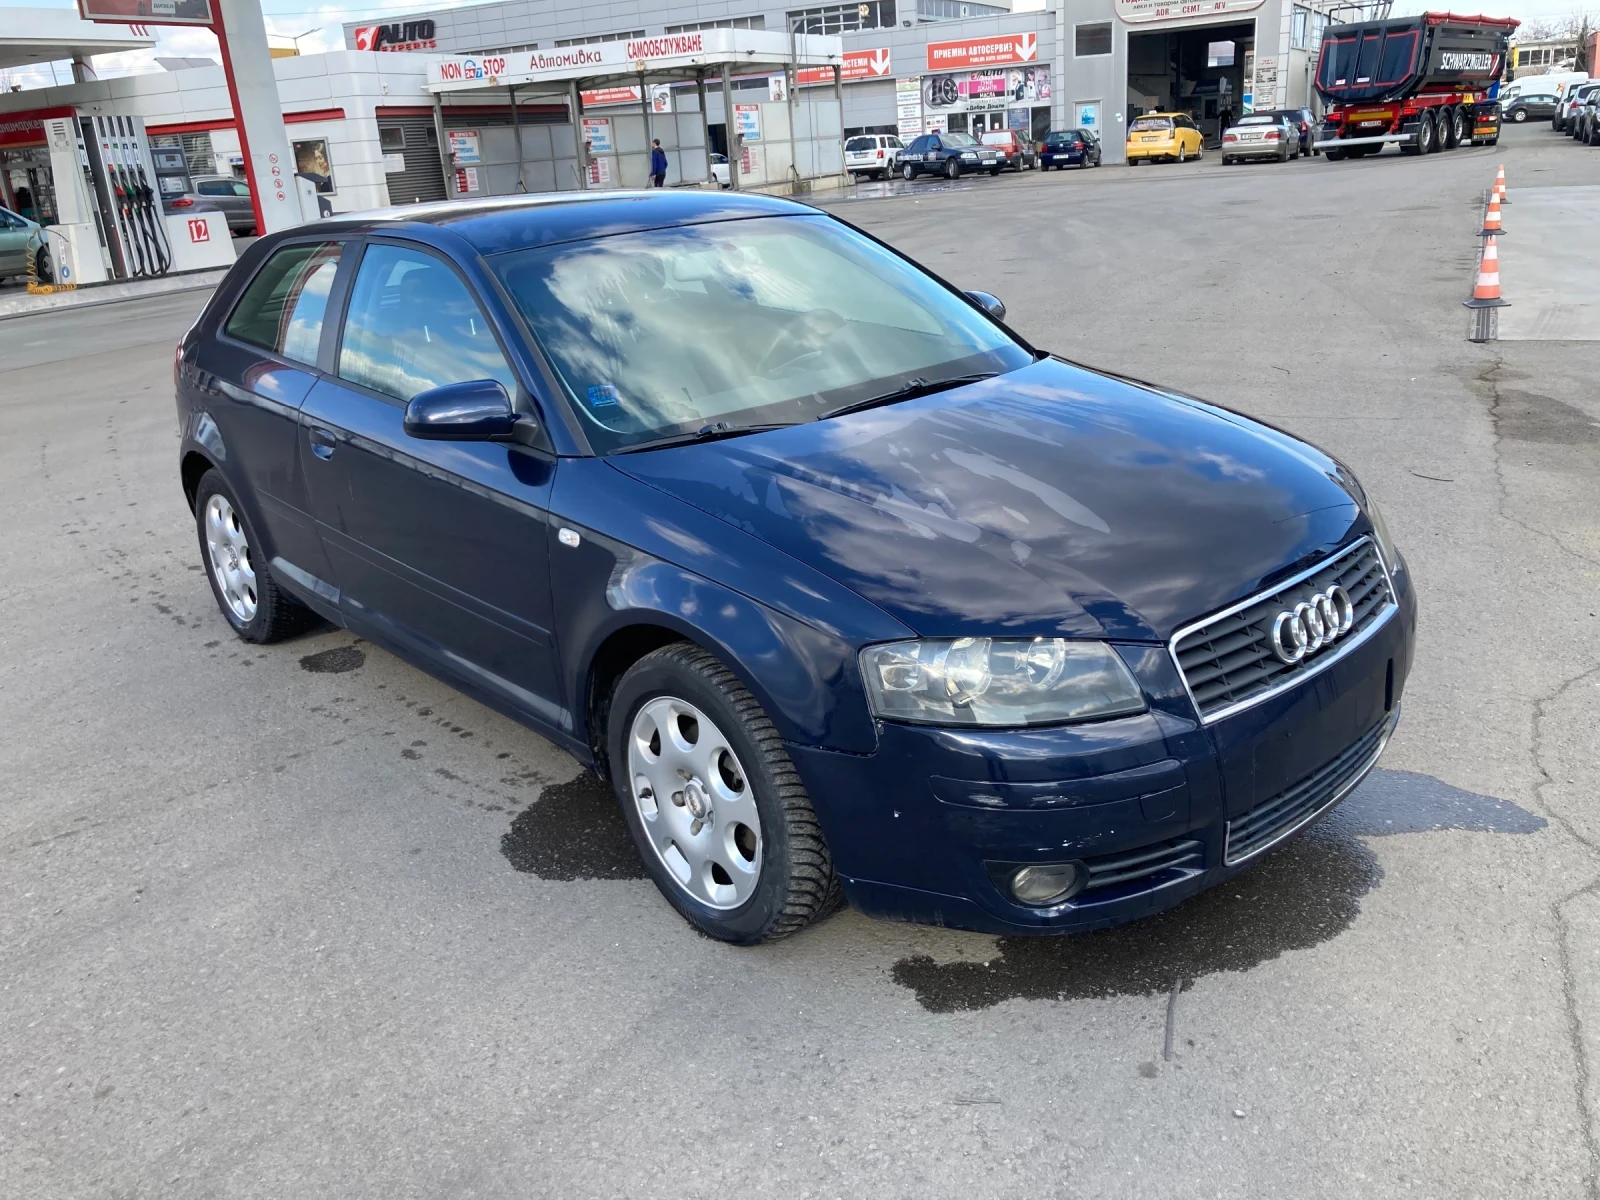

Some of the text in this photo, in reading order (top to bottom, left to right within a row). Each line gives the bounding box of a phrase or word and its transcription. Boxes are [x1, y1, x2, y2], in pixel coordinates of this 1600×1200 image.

[376, 19, 435, 46] AUTO
[380, 40, 437, 52] EXPERTS
[627, 34, 703, 59] САМООБСЛУЖВАНЕ
[933, 42, 1013, 59] ПРИЕМНА АВТОСЕРВИЗ
[440, 62, 463, 80] NON
[465, 70, 476, 79] 24
[482, 57, 506, 75] STOP
[530, 49, 603, 70] Автомивка
[840, 57, 868, 69] ИСТЕМИ
[1440, 52, 1492, 70] SCHWARZMÜLLER
[189, 220, 208, 242] 12
